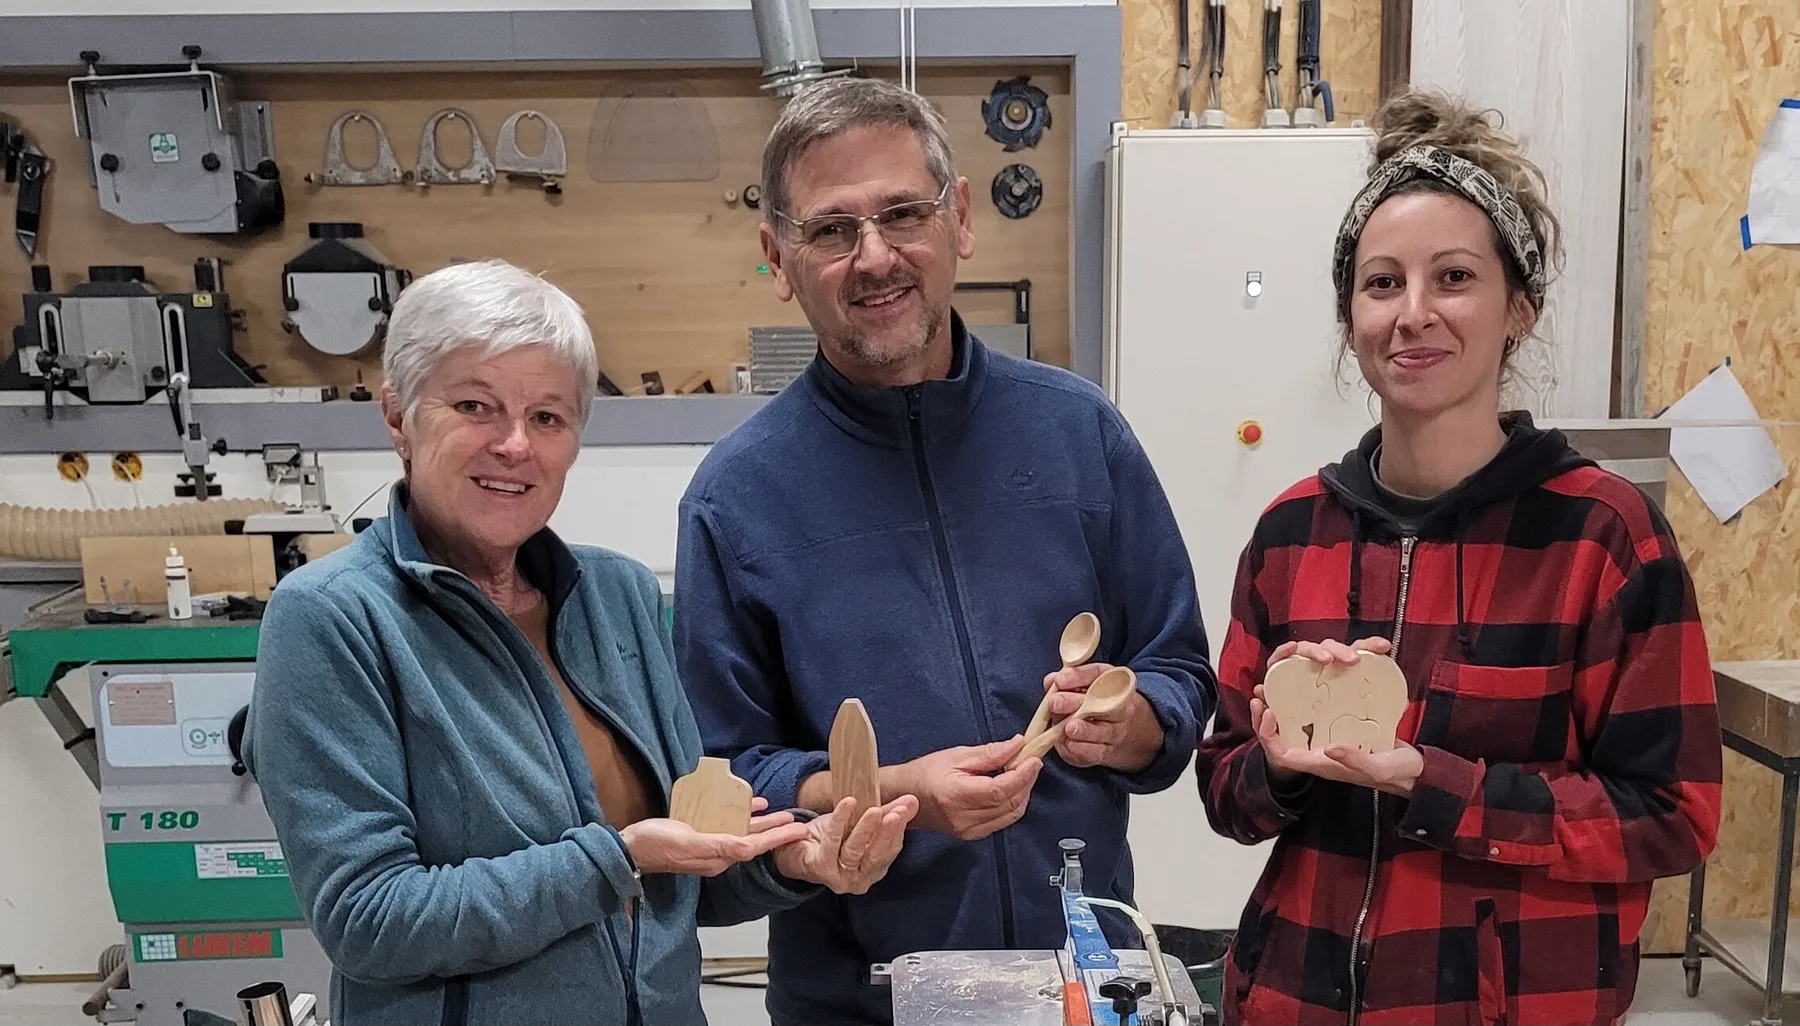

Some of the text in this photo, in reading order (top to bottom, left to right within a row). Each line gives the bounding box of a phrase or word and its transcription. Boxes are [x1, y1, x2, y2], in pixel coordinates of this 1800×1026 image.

[106, 810, 199, 831] T 180
[178, 931, 273, 958] LUREM
